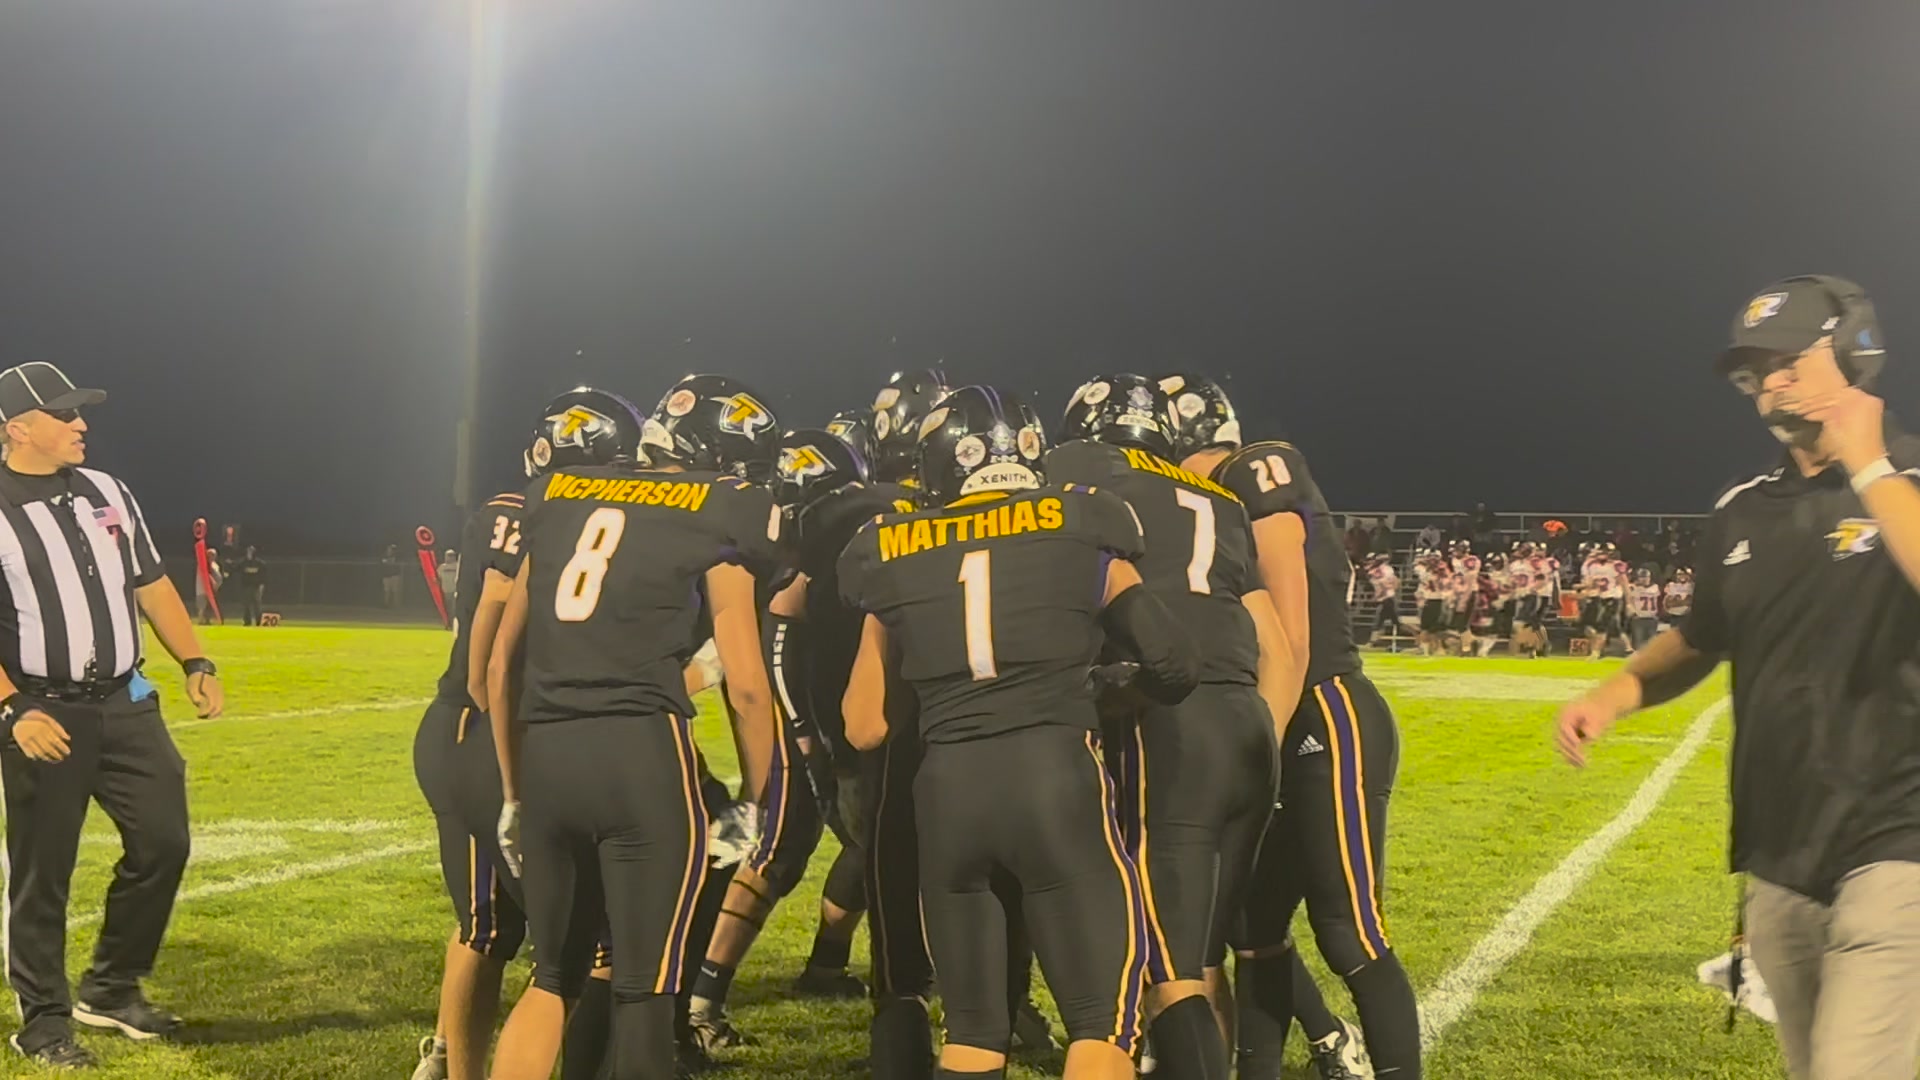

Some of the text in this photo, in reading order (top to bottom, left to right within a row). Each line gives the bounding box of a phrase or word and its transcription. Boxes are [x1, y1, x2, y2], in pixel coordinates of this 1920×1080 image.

[544, 473, 711, 511] MCPHERSON
[980, 472, 1028, 485] XENITH
[489, 514, 522, 555] 32
[878, 497, 1064, 562] MATTHIAS
[1175, 487, 1216, 594] 7
[554, 507, 627, 622] 8
[262, 615, 278, 627] 20
[958, 548, 998, 682] 1
